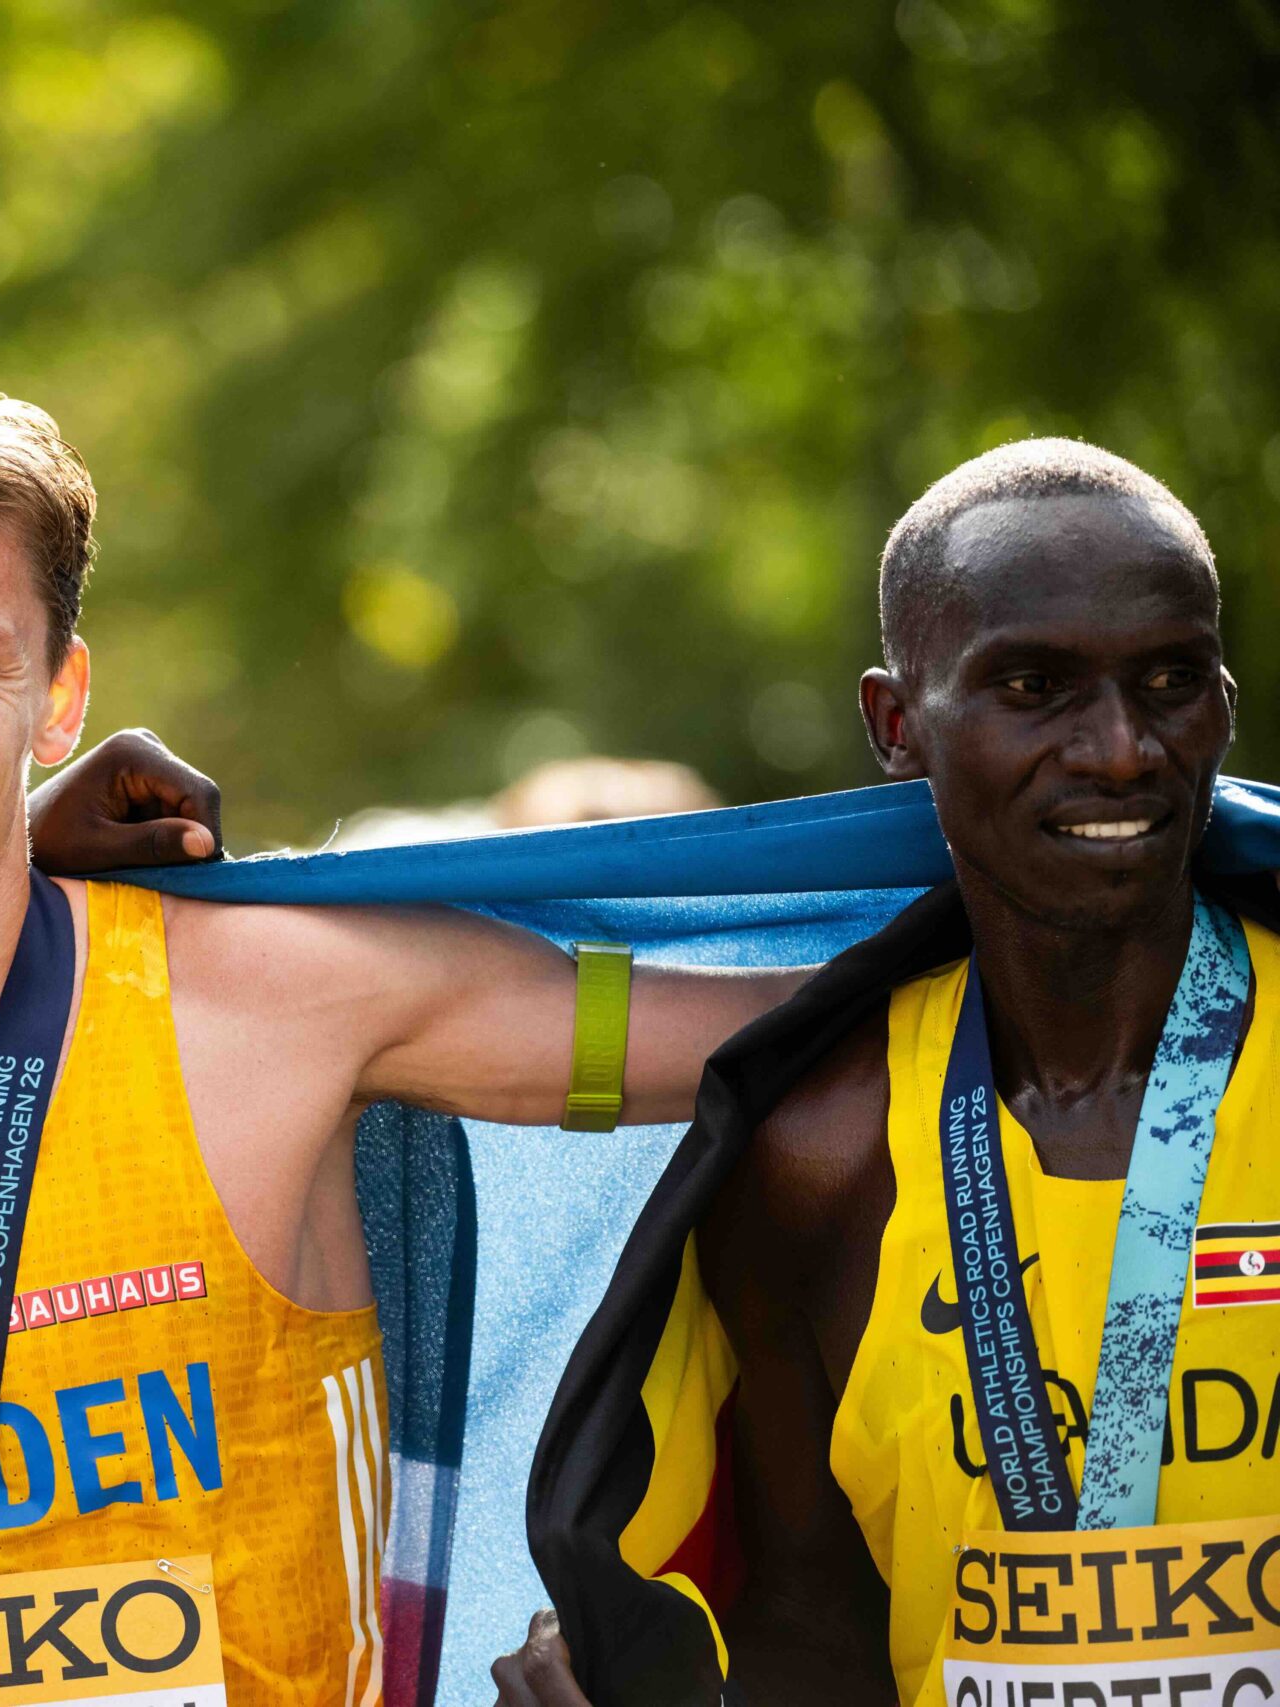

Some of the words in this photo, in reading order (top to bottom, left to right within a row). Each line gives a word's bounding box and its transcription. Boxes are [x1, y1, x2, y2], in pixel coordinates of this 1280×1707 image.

[20, 1056, 45, 1089] 26
[971, 1085, 986, 1120] 26
[949, 1095, 974, 1208] RUNNING
[959, 1211, 985, 1282] ROAD
[972, 1121, 1011, 1298] COPENHAGEN
[970, 1285, 1010, 1419] ATHLETICS
[996, 1302, 1062, 1514] CHAMPIONSHIPS
[994, 1425, 1034, 1519] WORLD
